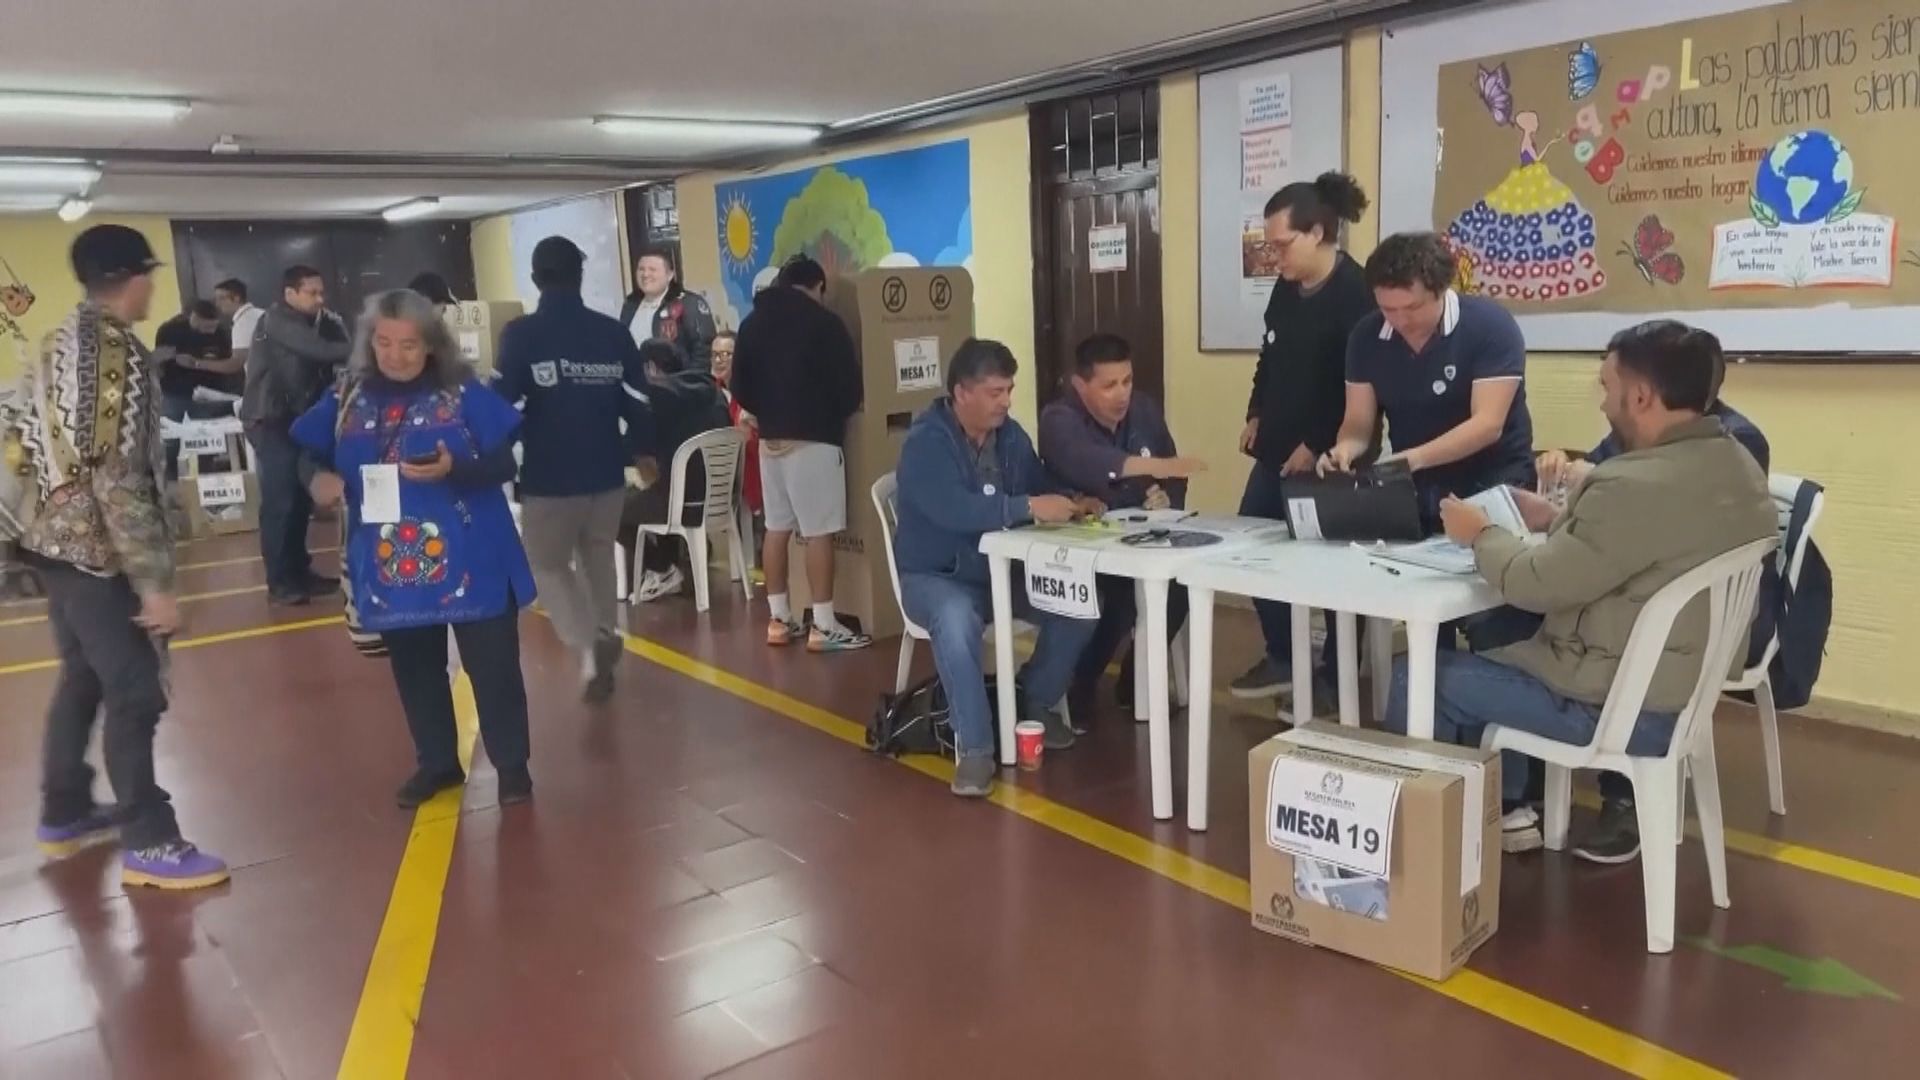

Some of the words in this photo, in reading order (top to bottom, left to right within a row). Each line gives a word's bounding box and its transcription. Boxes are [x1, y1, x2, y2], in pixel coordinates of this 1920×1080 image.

[1680, 38, 1731, 90] Las
[1745, 15, 1857, 91] palabras
[1766, 75, 1831, 126] tierra
[1854, 60, 1920, 115] siem
[1626, 150, 1679, 172] Cuidemos
[1683, 146, 1726, 168] nuestro
[1608, 182, 1658, 204] Cuidemos
[1663, 177, 1704, 200] nuestro
[1726, 230, 1740, 243] En
[900, 367, 924, 381] MESA
[926, 364, 937, 378] 17
[185, 439, 209, 449] MESA
[203, 489, 228, 499] MESA
[1031, 573, 1066, 599] MESA
[1069, 582, 1089, 603] 19
[1276, 803, 1340, 846] MESA
[1346, 824, 1380, 854] 19
